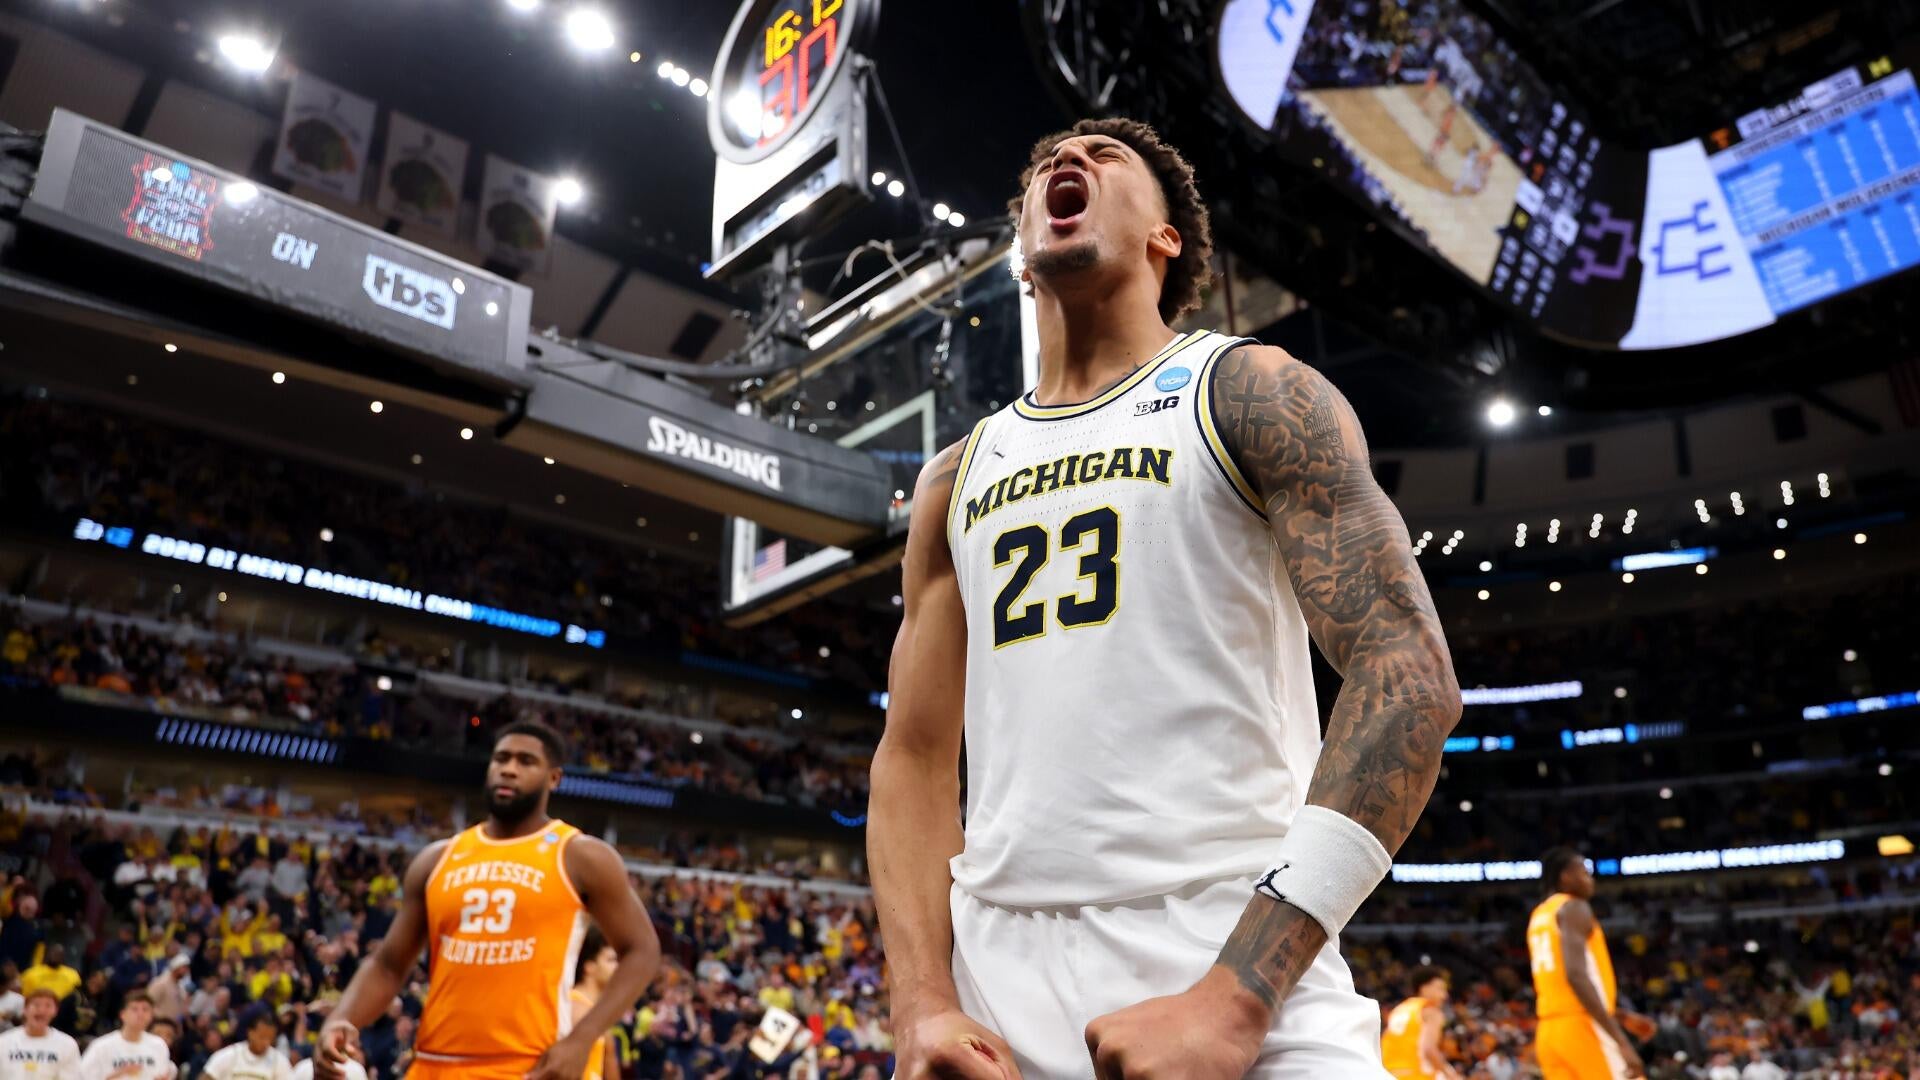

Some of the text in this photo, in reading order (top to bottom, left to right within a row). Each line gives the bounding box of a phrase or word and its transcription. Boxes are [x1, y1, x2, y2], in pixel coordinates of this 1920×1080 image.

[271, 232, 319, 271] ON
[371, 262, 448, 318] tbs
[647, 415, 782, 492] SPALDING
[964, 447, 1174, 537] MICHIGAN
[304, 568, 423, 610] BASKETBALL
[993, 503, 1121, 651] 23
[443, 861, 545, 892] TENNESSEE
[1620, 850, 1721, 875] MICHIGAN
[1721, 839, 1845, 868] WOLVERINES
[459, 888, 516, 933] 23
